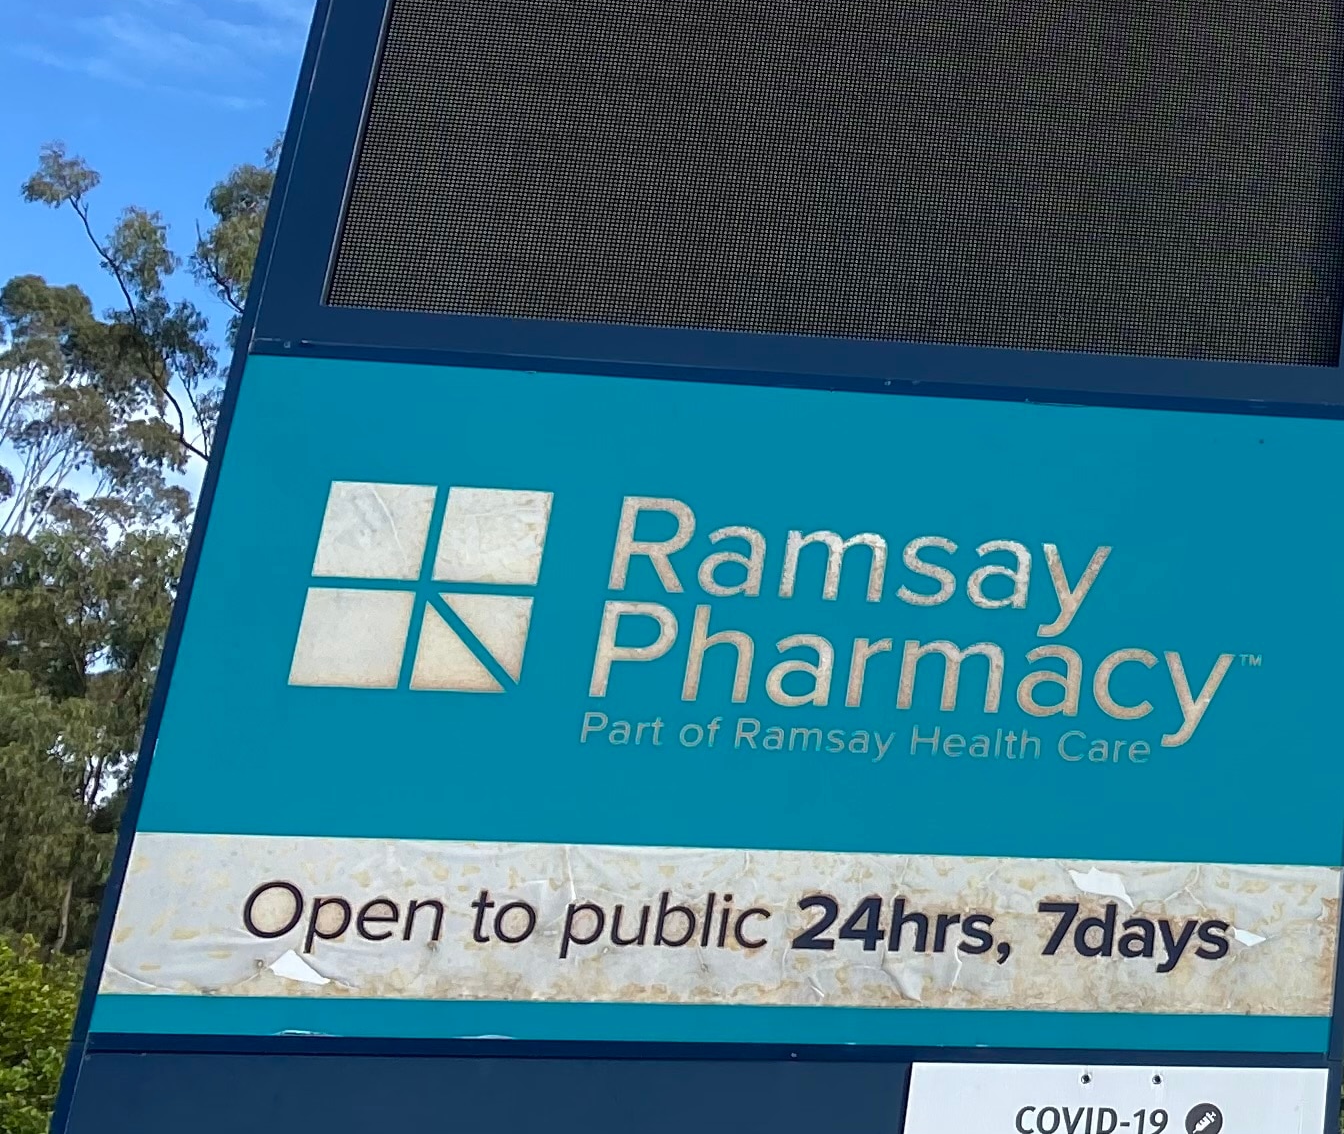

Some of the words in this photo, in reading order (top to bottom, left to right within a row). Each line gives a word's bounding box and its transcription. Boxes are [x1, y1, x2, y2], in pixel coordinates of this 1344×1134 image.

[607, 495, 1112, 638] Ramsay
[588, 600, 1236, 748] Pharmacy
[580, 711, 664, 745] Part
[679, 716, 721, 746] of
[734, 717, 895, 763] Ramsay
[910, 725, 1041, 760] Health
[1057, 731, 1151, 763] Care
[243, 881, 444, 954] Open
[471, 890, 537, 944] to
[559, 891, 771, 959] public
[791, 894, 1011, 965] 24hrs,
[1038, 901, 1230, 974] 7days
[1015, 1106, 1168, 1134] COVID-19
